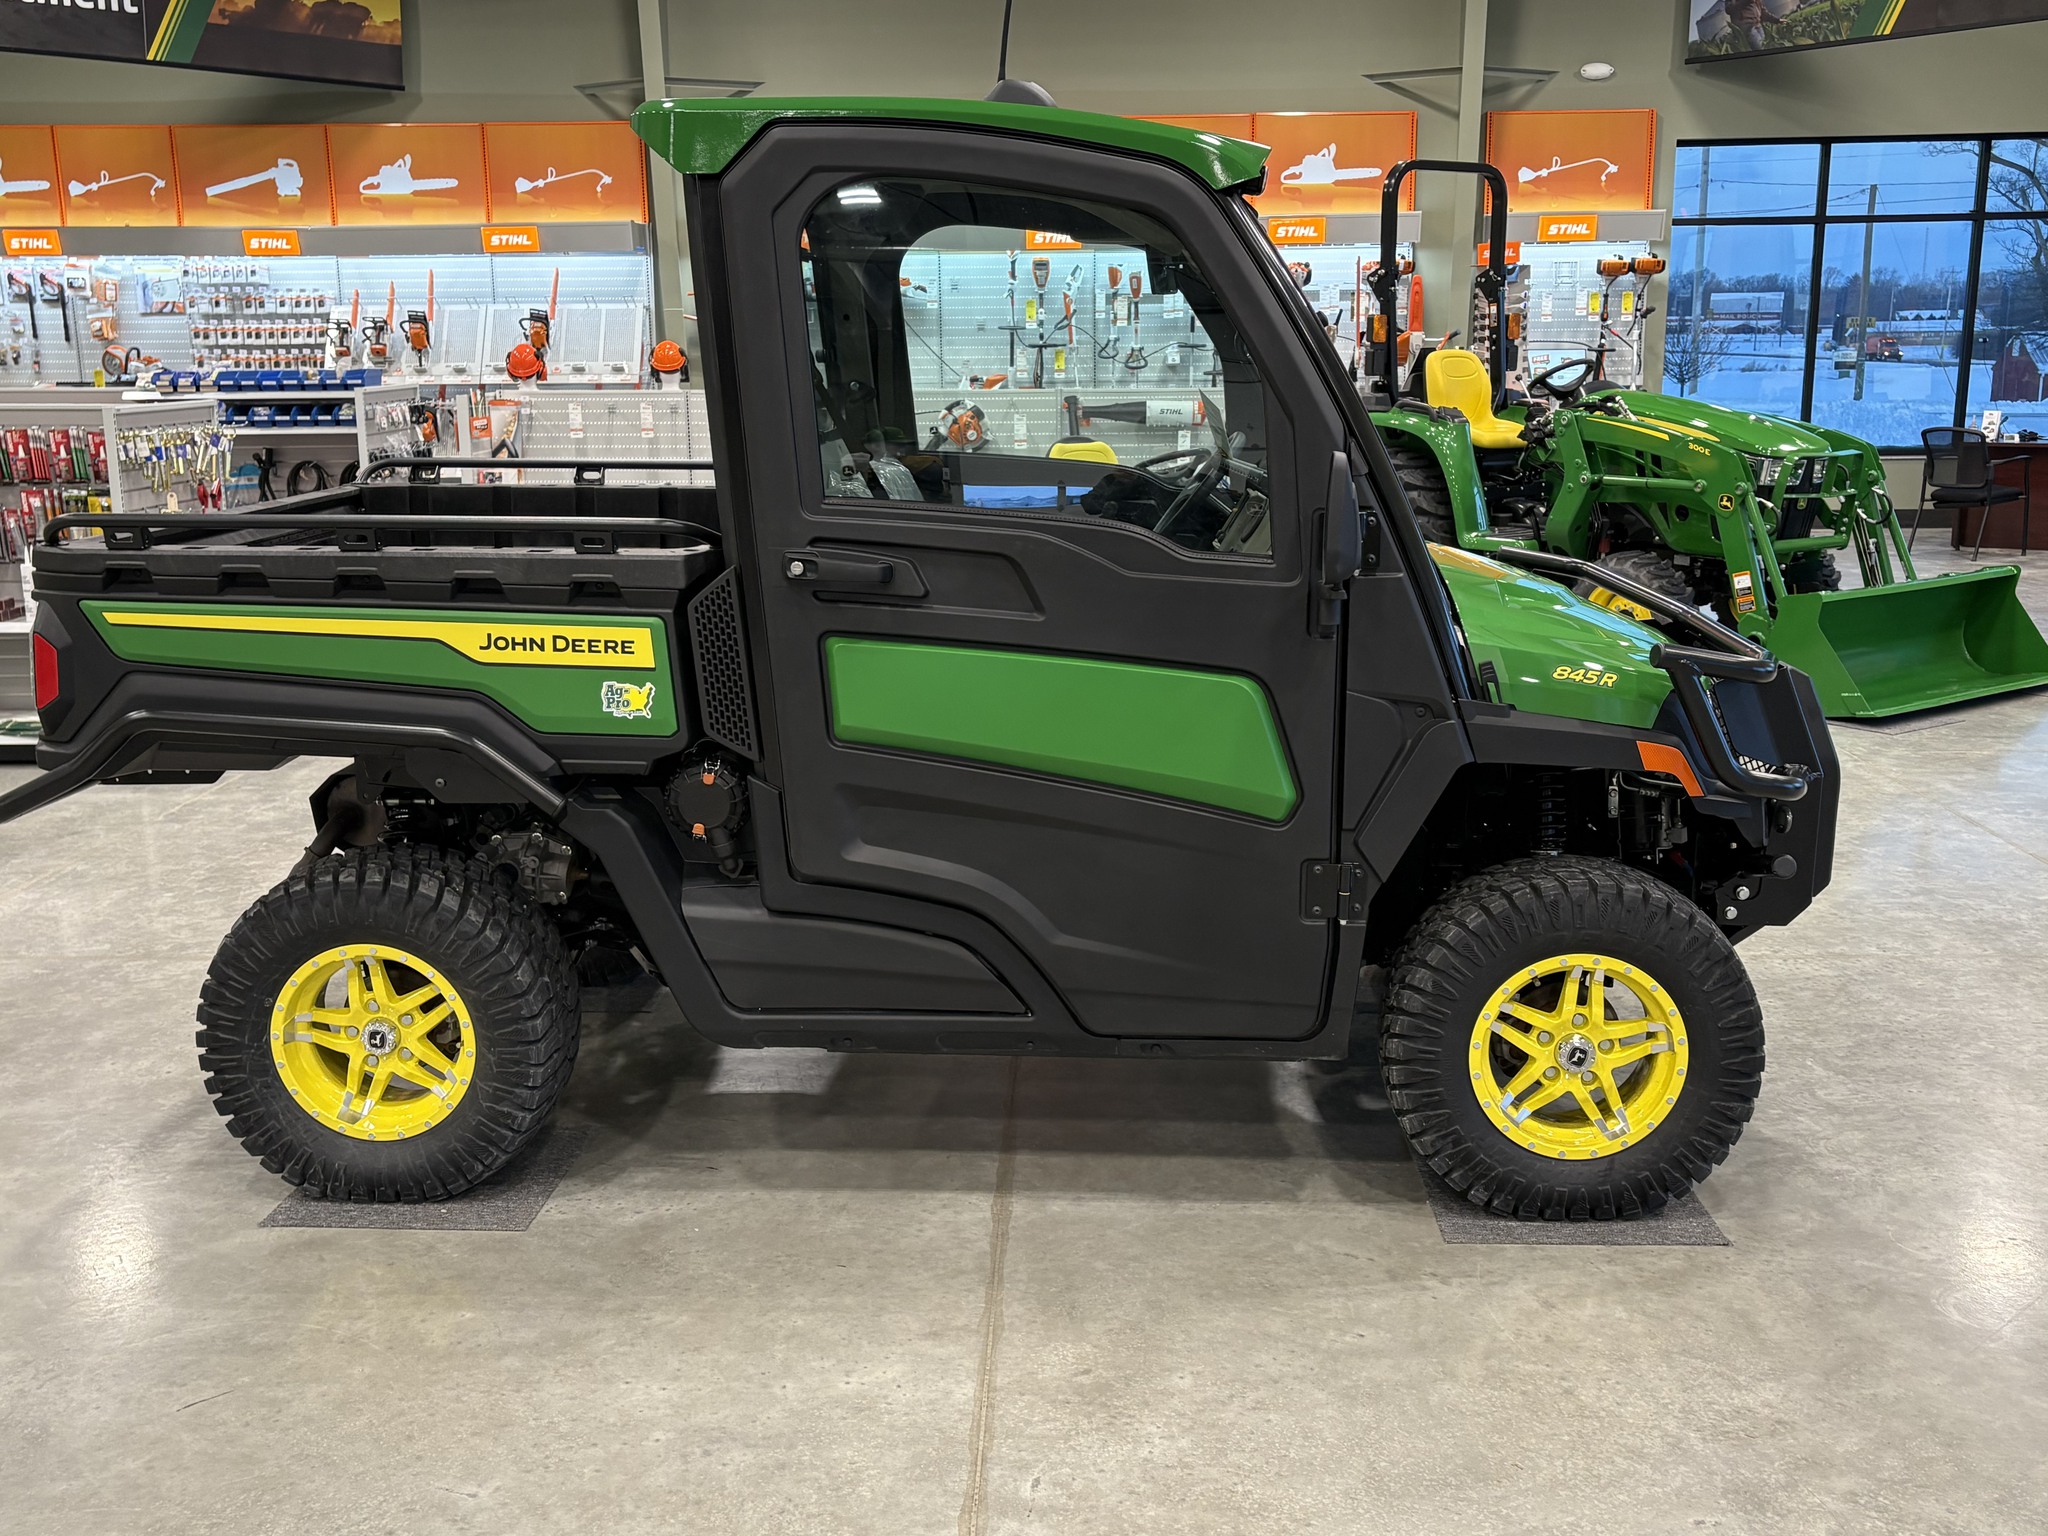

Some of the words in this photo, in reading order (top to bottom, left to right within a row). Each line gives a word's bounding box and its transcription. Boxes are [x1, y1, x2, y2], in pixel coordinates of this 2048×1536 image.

[1275, 225, 1319, 238] STIHL
[1547, 223, 1591, 235] STIHL
[10, 237, 53, 249] STIHL
[249, 237, 292, 249] STIHL
[490, 234, 533, 246] STIHL
[479, 633, 545, 652] JOHN
[552, 634, 635, 655] DEERE
[605, 684, 629, 698] Ag-
[606, 697, 631, 709] Pro
